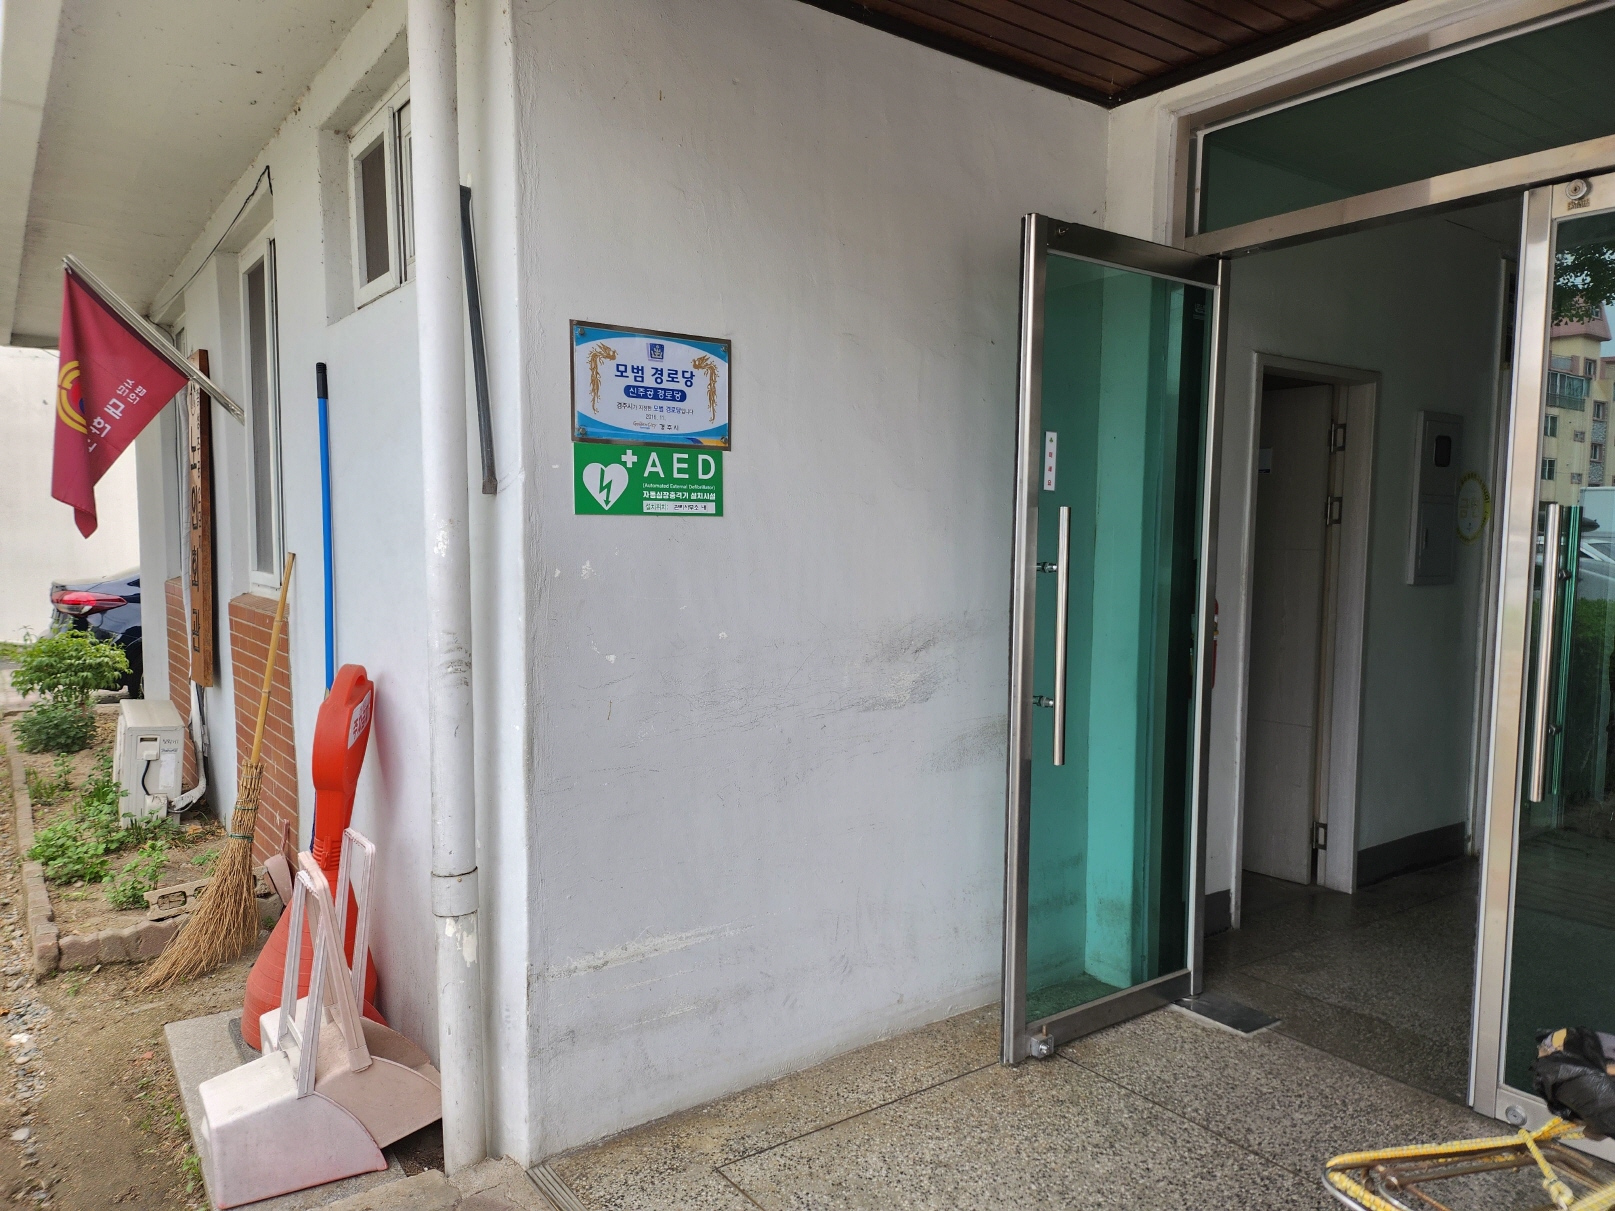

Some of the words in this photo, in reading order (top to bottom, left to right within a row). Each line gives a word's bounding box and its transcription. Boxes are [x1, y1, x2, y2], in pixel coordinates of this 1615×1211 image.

[614, 363, 645, 383] 모범
[651, 366, 696, 388] 경로당
[629, 386, 654, 399] 신주공
[657, 389, 682, 401] 경로당
[643, 451, 716, 480] AED
[642, 490, 689, 500] 자동심장충격기
[690, 491, 716, 501] 설치시설
